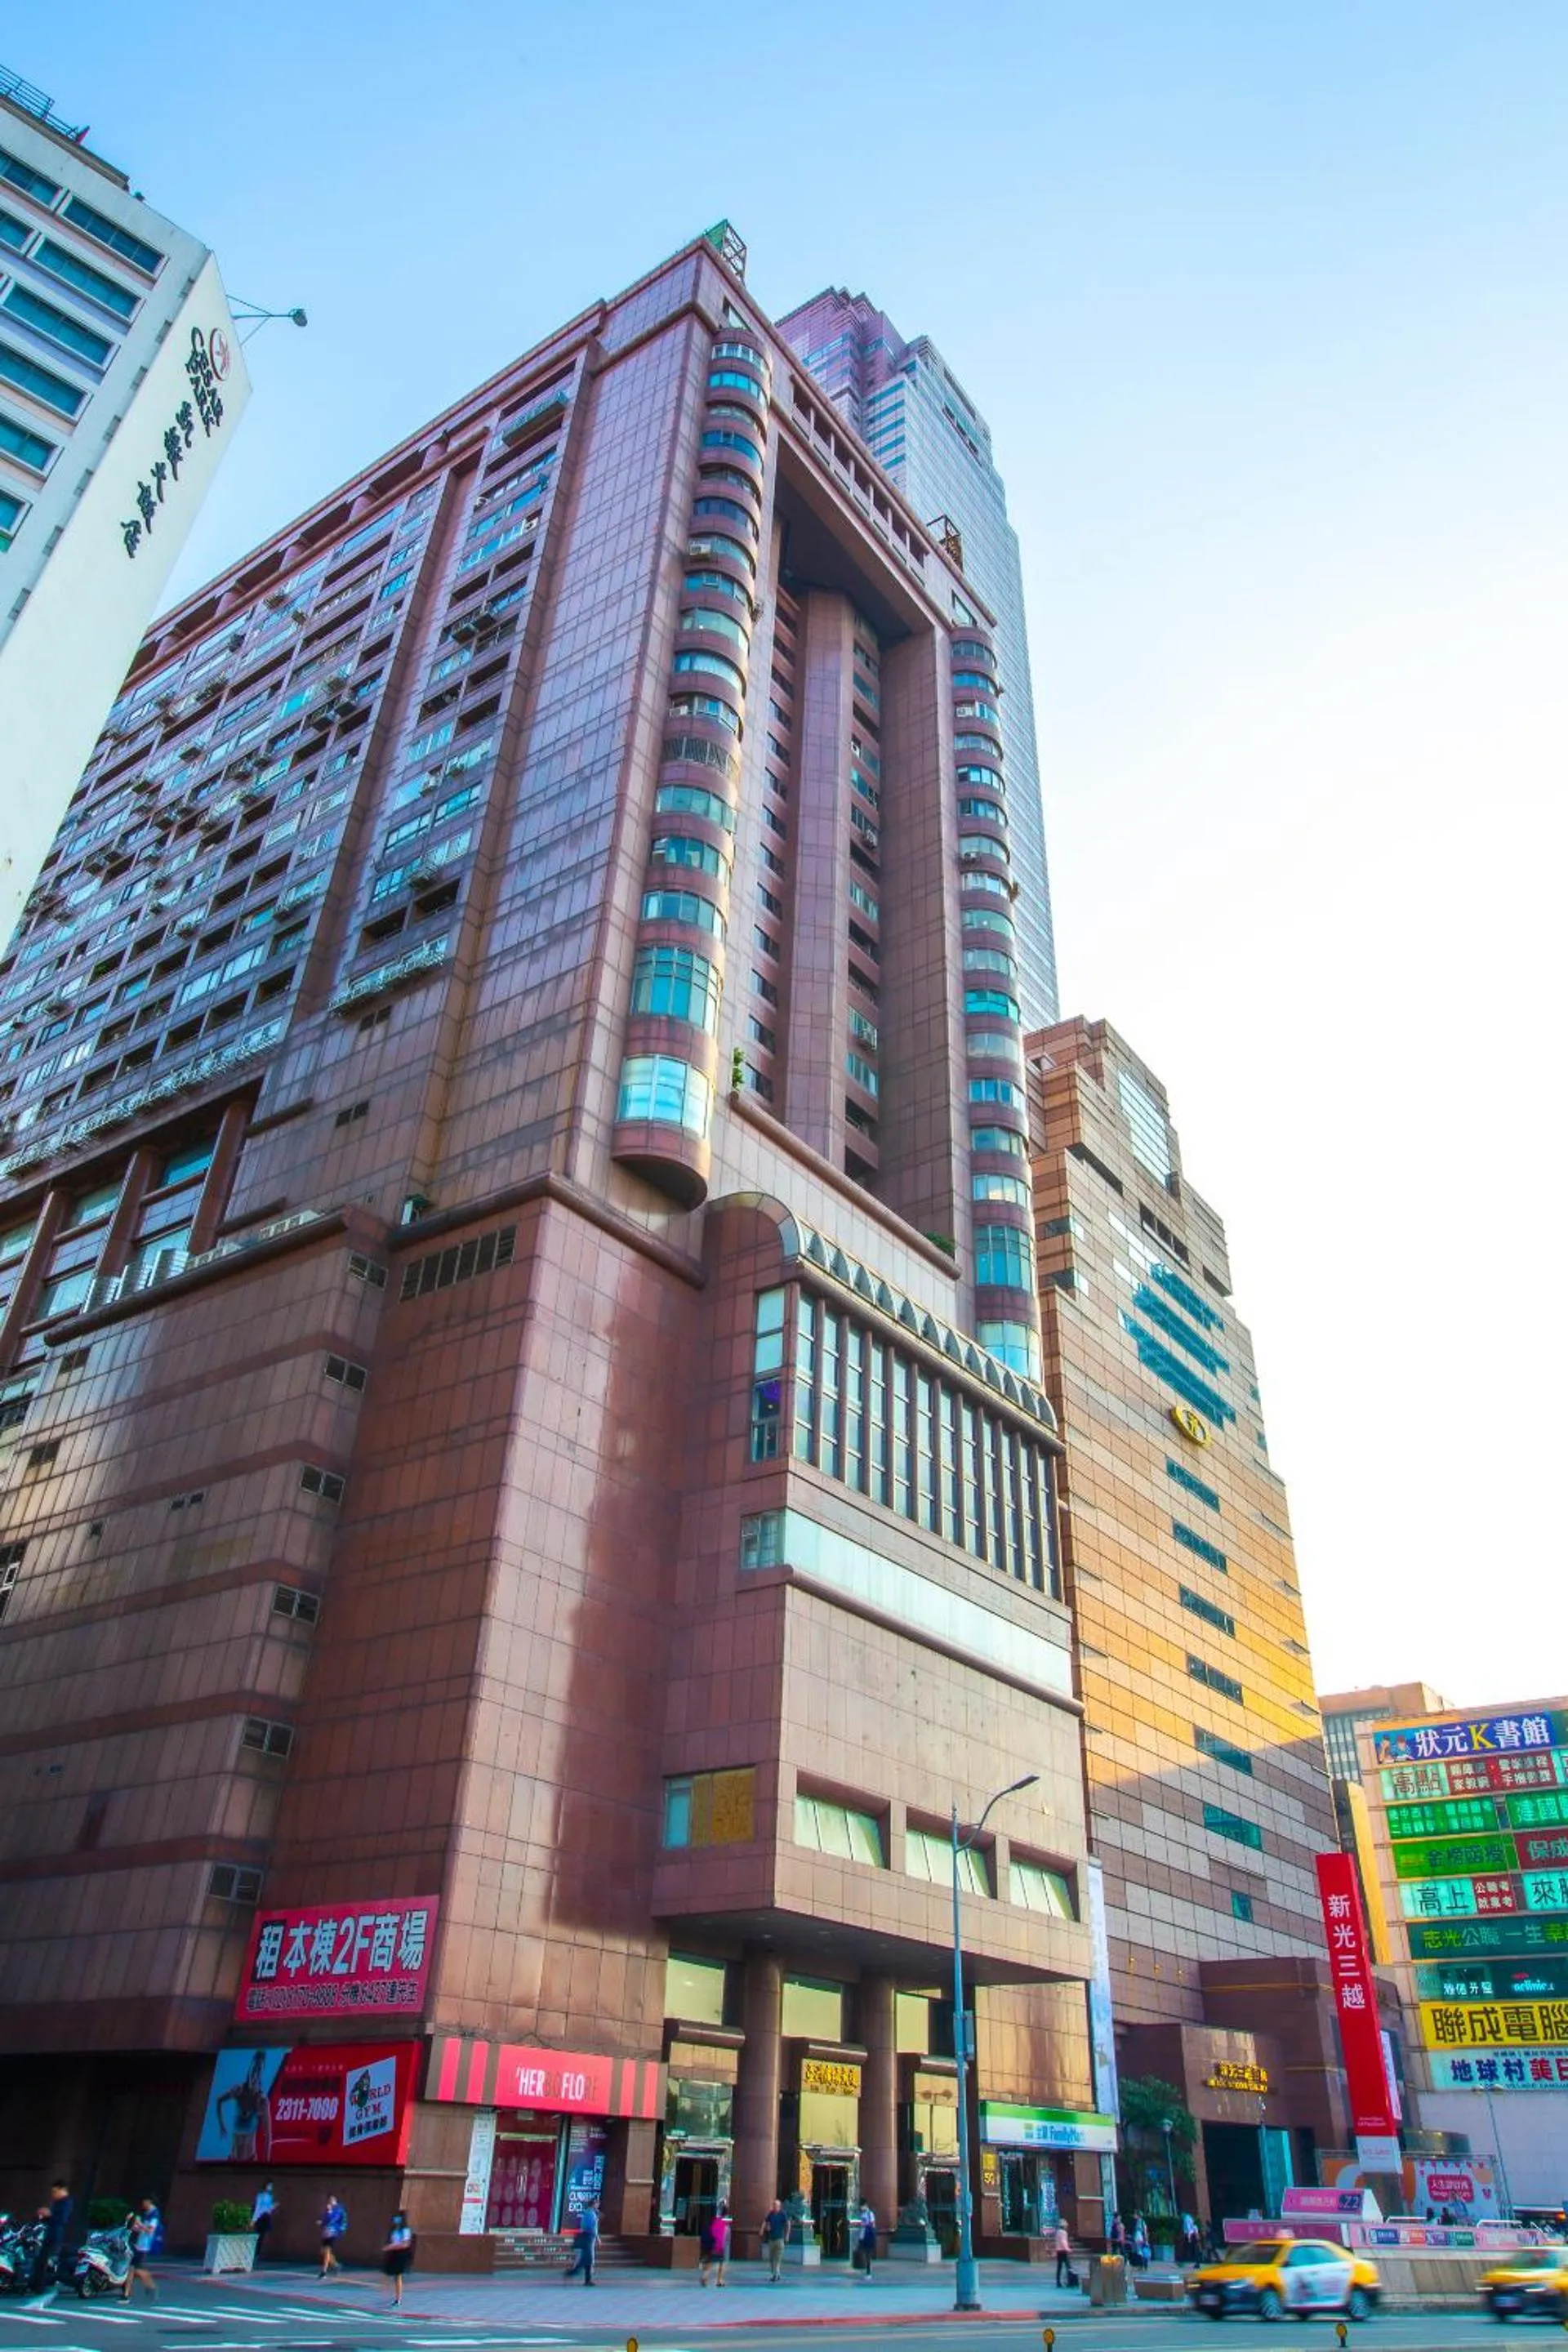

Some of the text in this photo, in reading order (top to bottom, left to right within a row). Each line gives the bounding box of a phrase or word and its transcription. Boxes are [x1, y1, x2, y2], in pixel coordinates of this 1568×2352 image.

[1414, 1717, 1550, 1757] 狀元K書館
[1417, 1885, 1469, 1913] 高上
[256, 1910, 429, 1980] 租本棟2F商場
[1327, 1894, 1365, 2009] 新光三越
[1430, 2003, 1568, 2043] 聯成電腦
[275, 2096, 340, 2121] 2311-7000
